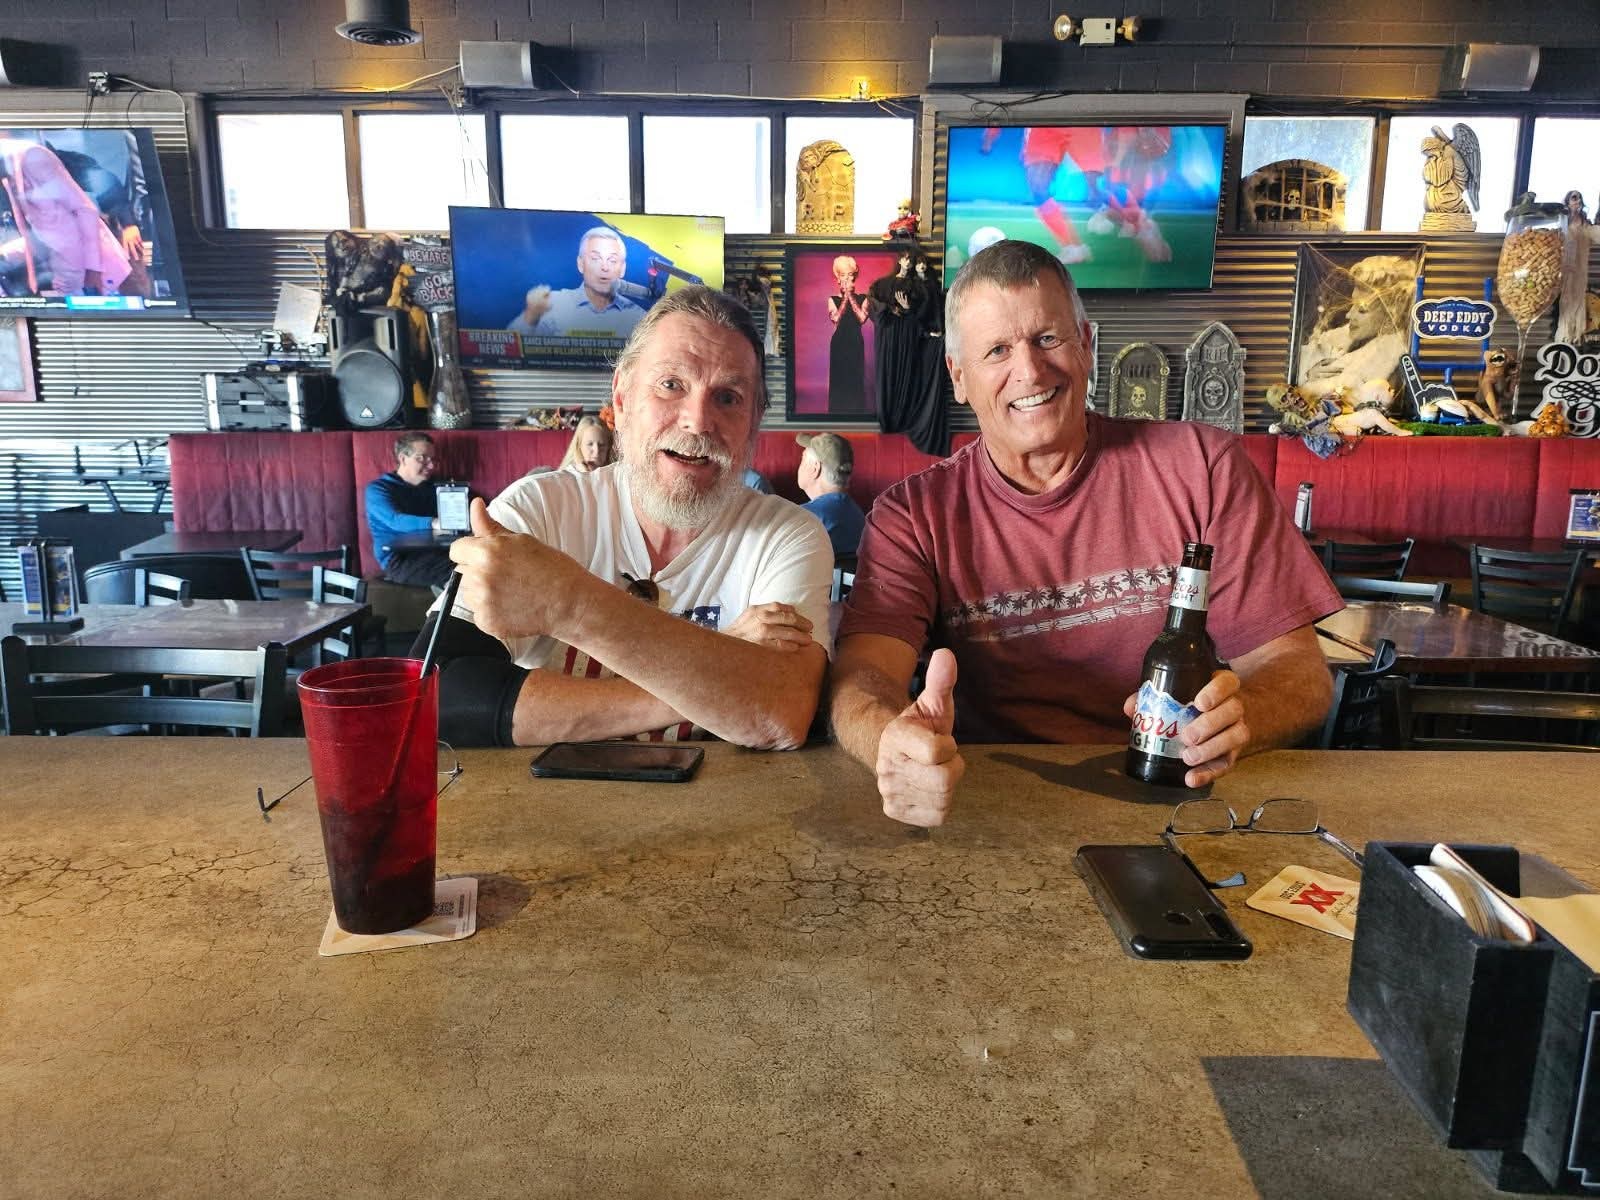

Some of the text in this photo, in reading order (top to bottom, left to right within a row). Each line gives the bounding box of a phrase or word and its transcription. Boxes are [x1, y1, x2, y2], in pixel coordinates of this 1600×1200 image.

[409, 249, 449, 264] BEWARE
[424, 274, 441, 289] GO
[420, 286, 453, 301] BACK
[1423, 310, 1488, 324] DEEP EDDY
[1427, 324, 1483, 333] VODKA
[469, 332, 515, 343] BREAKING
[479, 344, 506, 355] NEWS
[1541, 343, 1600, 379] Do
[1173, 582, 1200, 595] oors
[1133, 712, 1179, 739] oors
